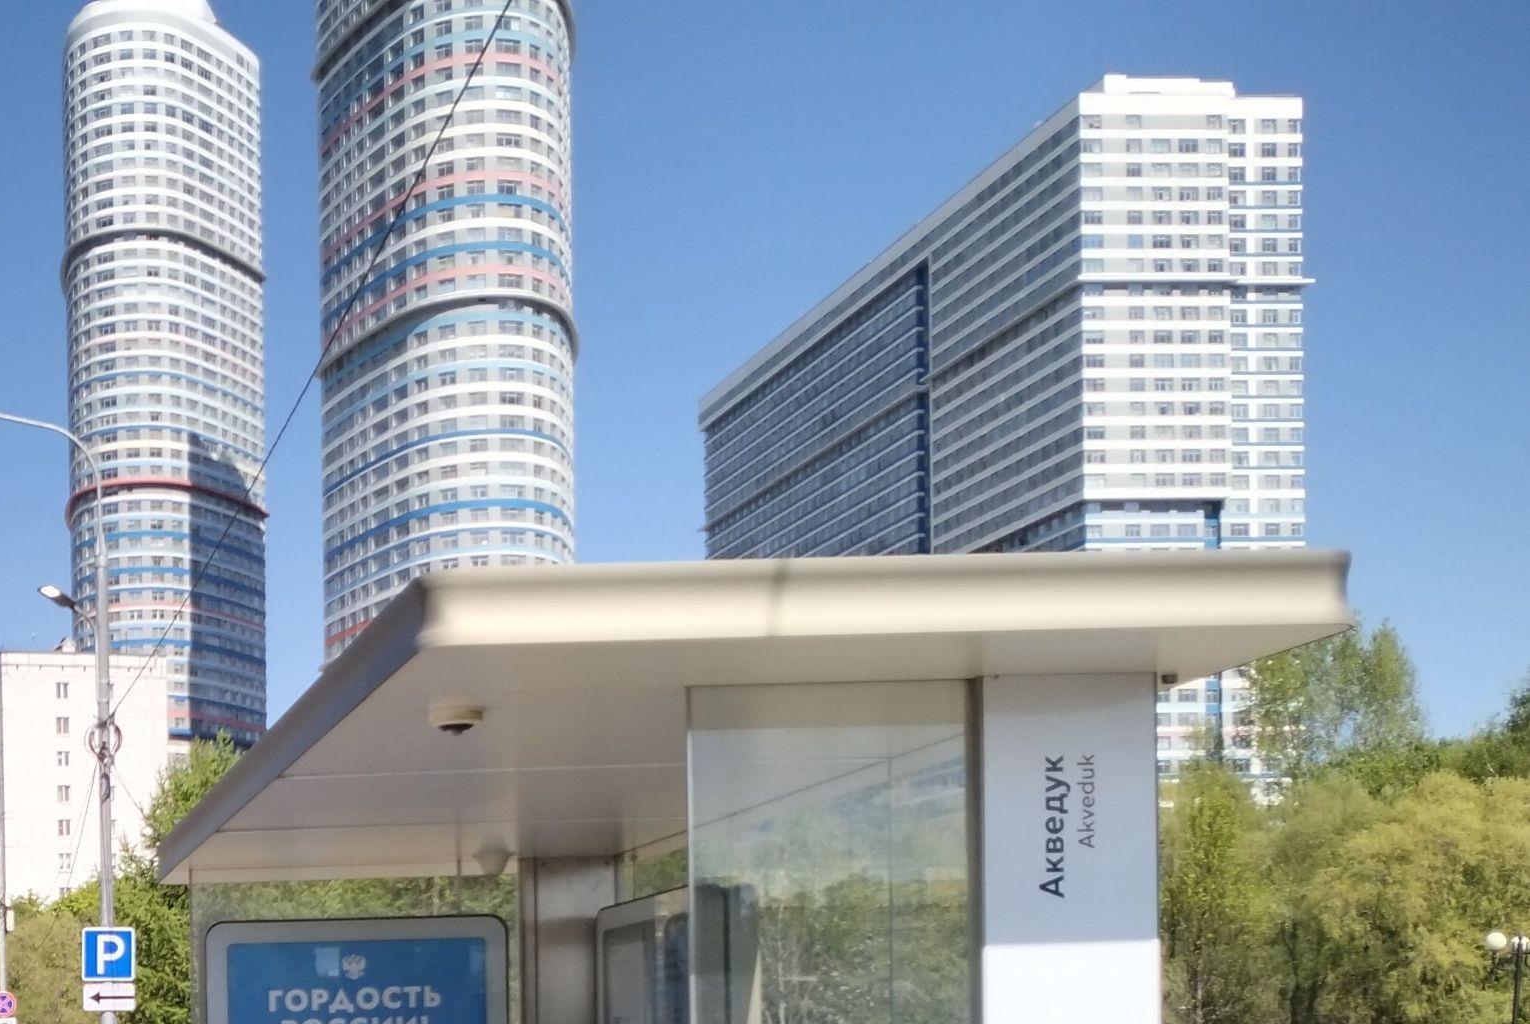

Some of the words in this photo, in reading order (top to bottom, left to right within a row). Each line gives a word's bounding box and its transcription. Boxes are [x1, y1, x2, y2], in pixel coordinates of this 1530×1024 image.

[1039, 755, 1071, 898] Акведук
[1076, 754, 1095, 848] Akveduk
[97, 934, 125, 975] P
[268, 985, 441, 1014] ГОРДОСТЬ
